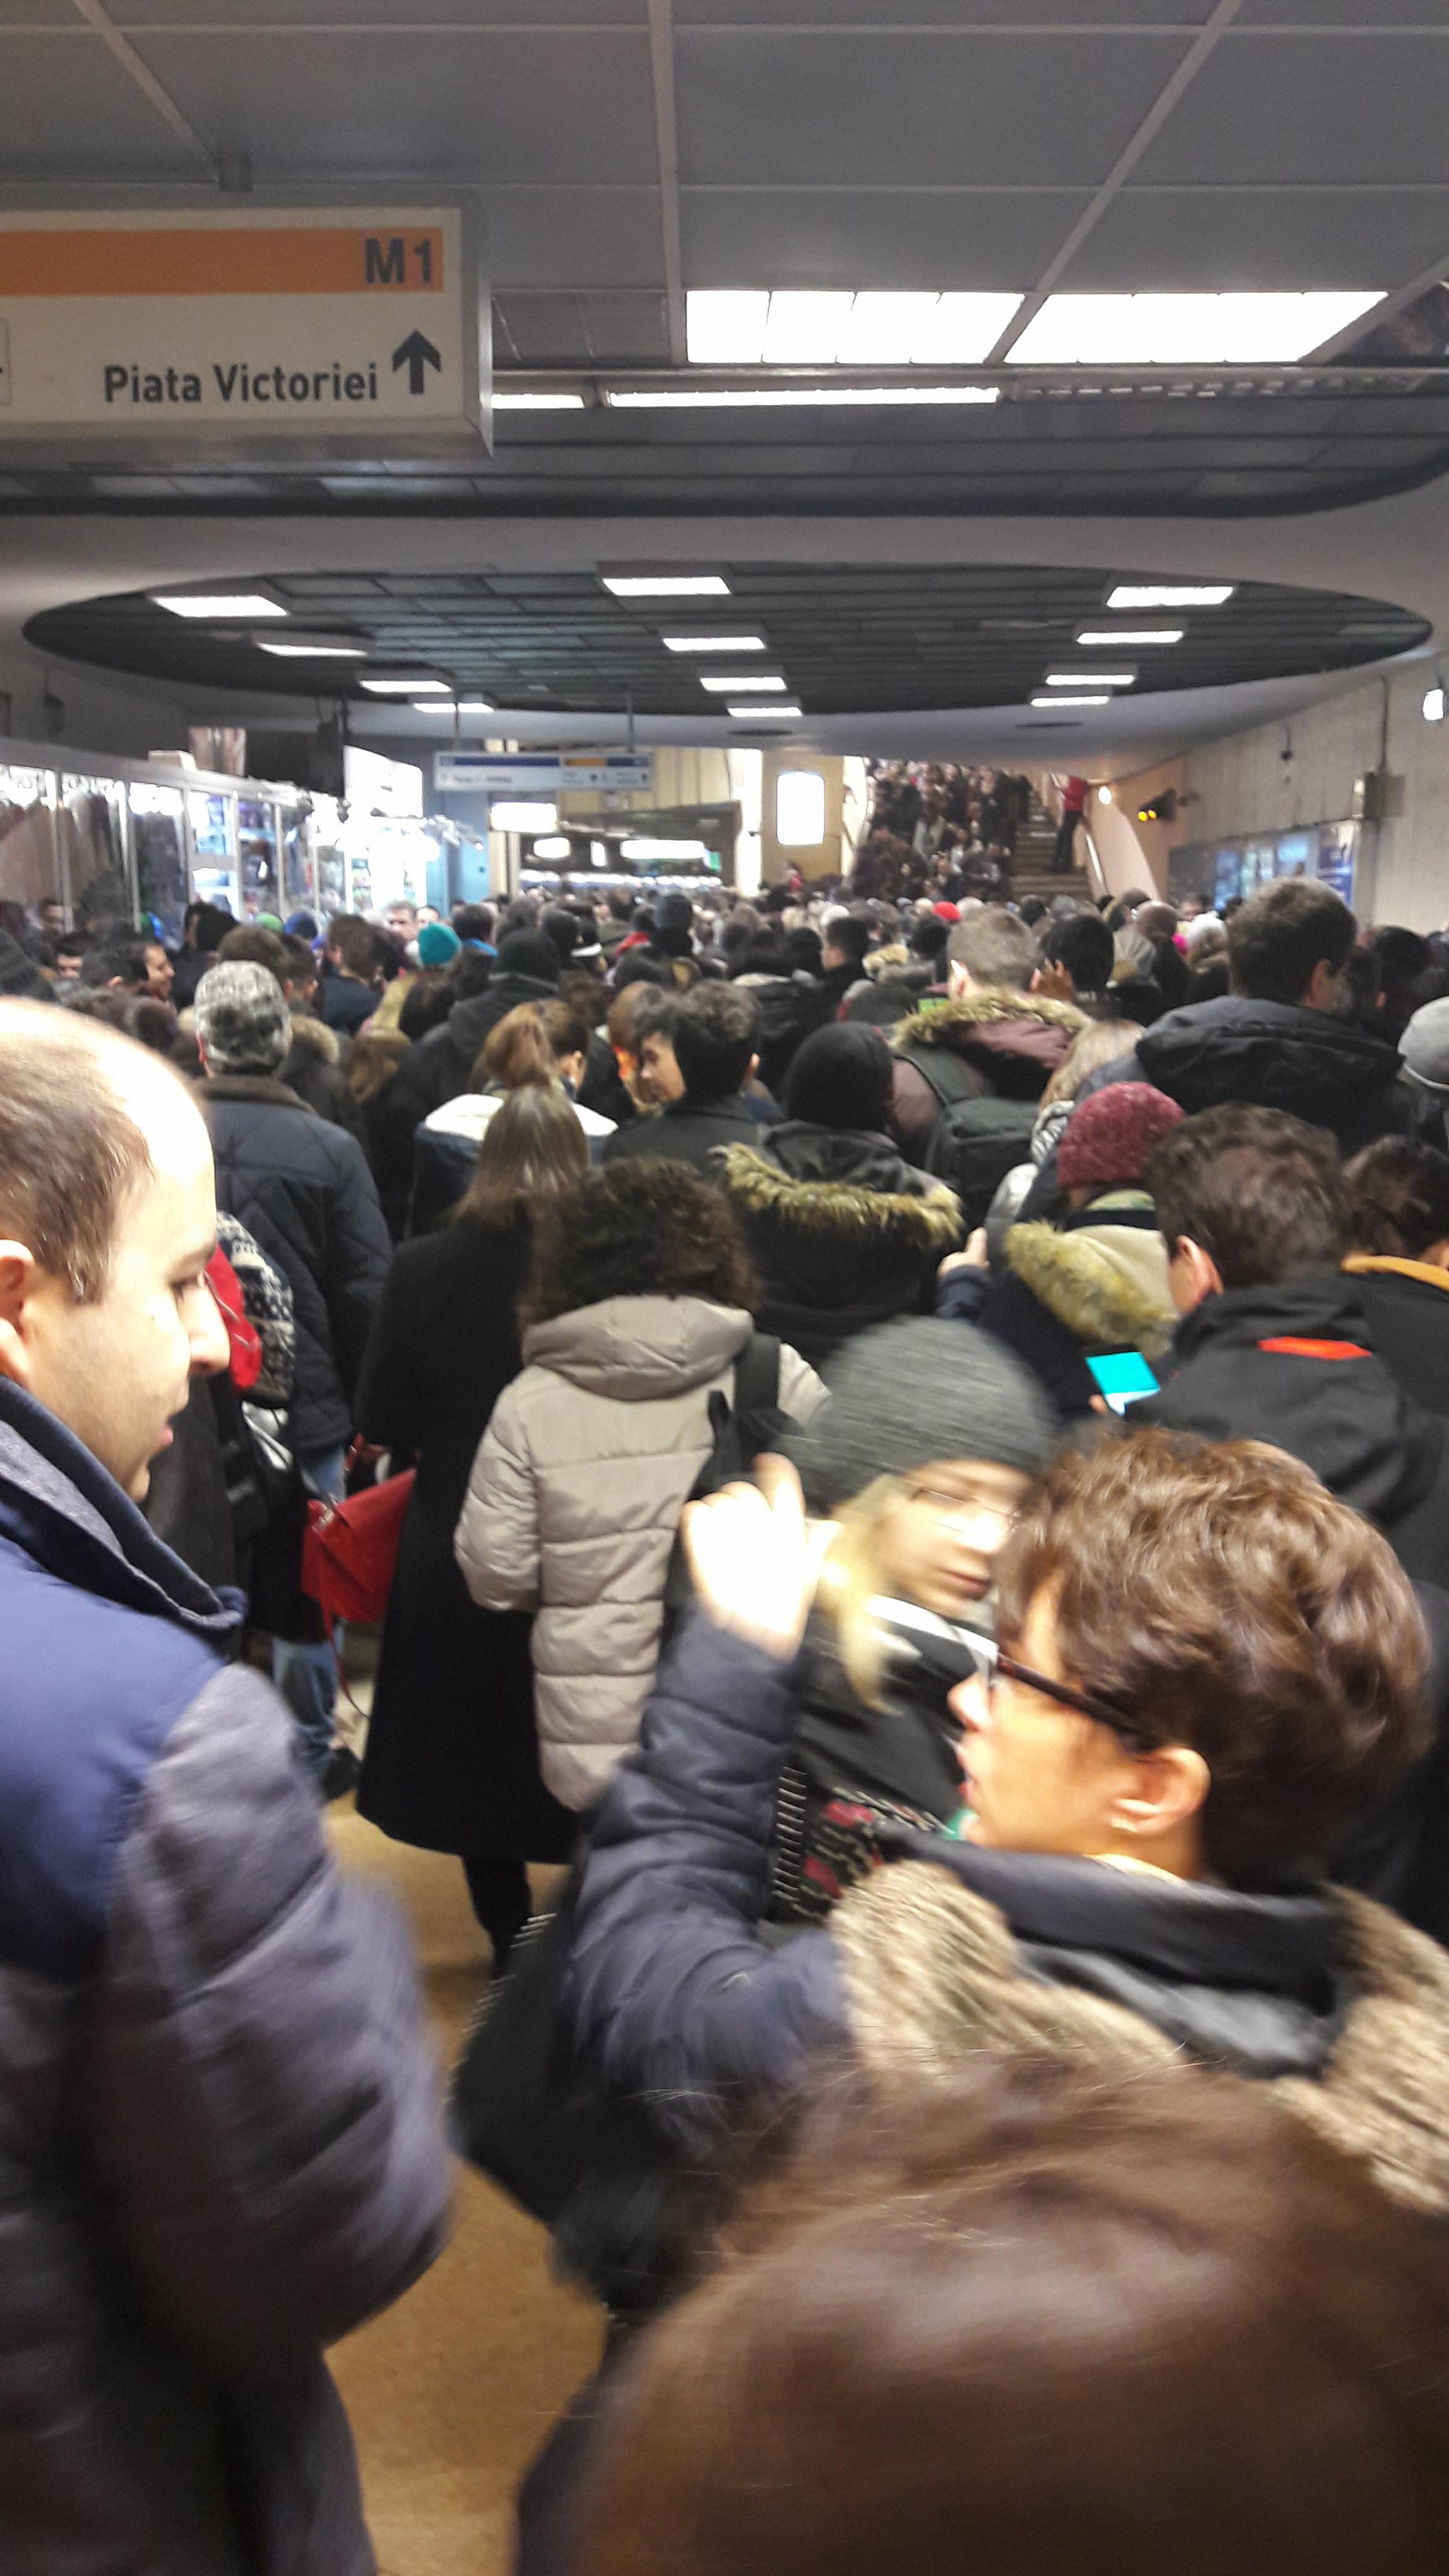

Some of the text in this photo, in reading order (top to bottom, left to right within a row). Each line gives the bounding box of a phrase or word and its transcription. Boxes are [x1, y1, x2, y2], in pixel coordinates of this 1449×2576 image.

[364, 237, 432, 284] M1
[104, 362, 378, 404] Piata Victoriei
